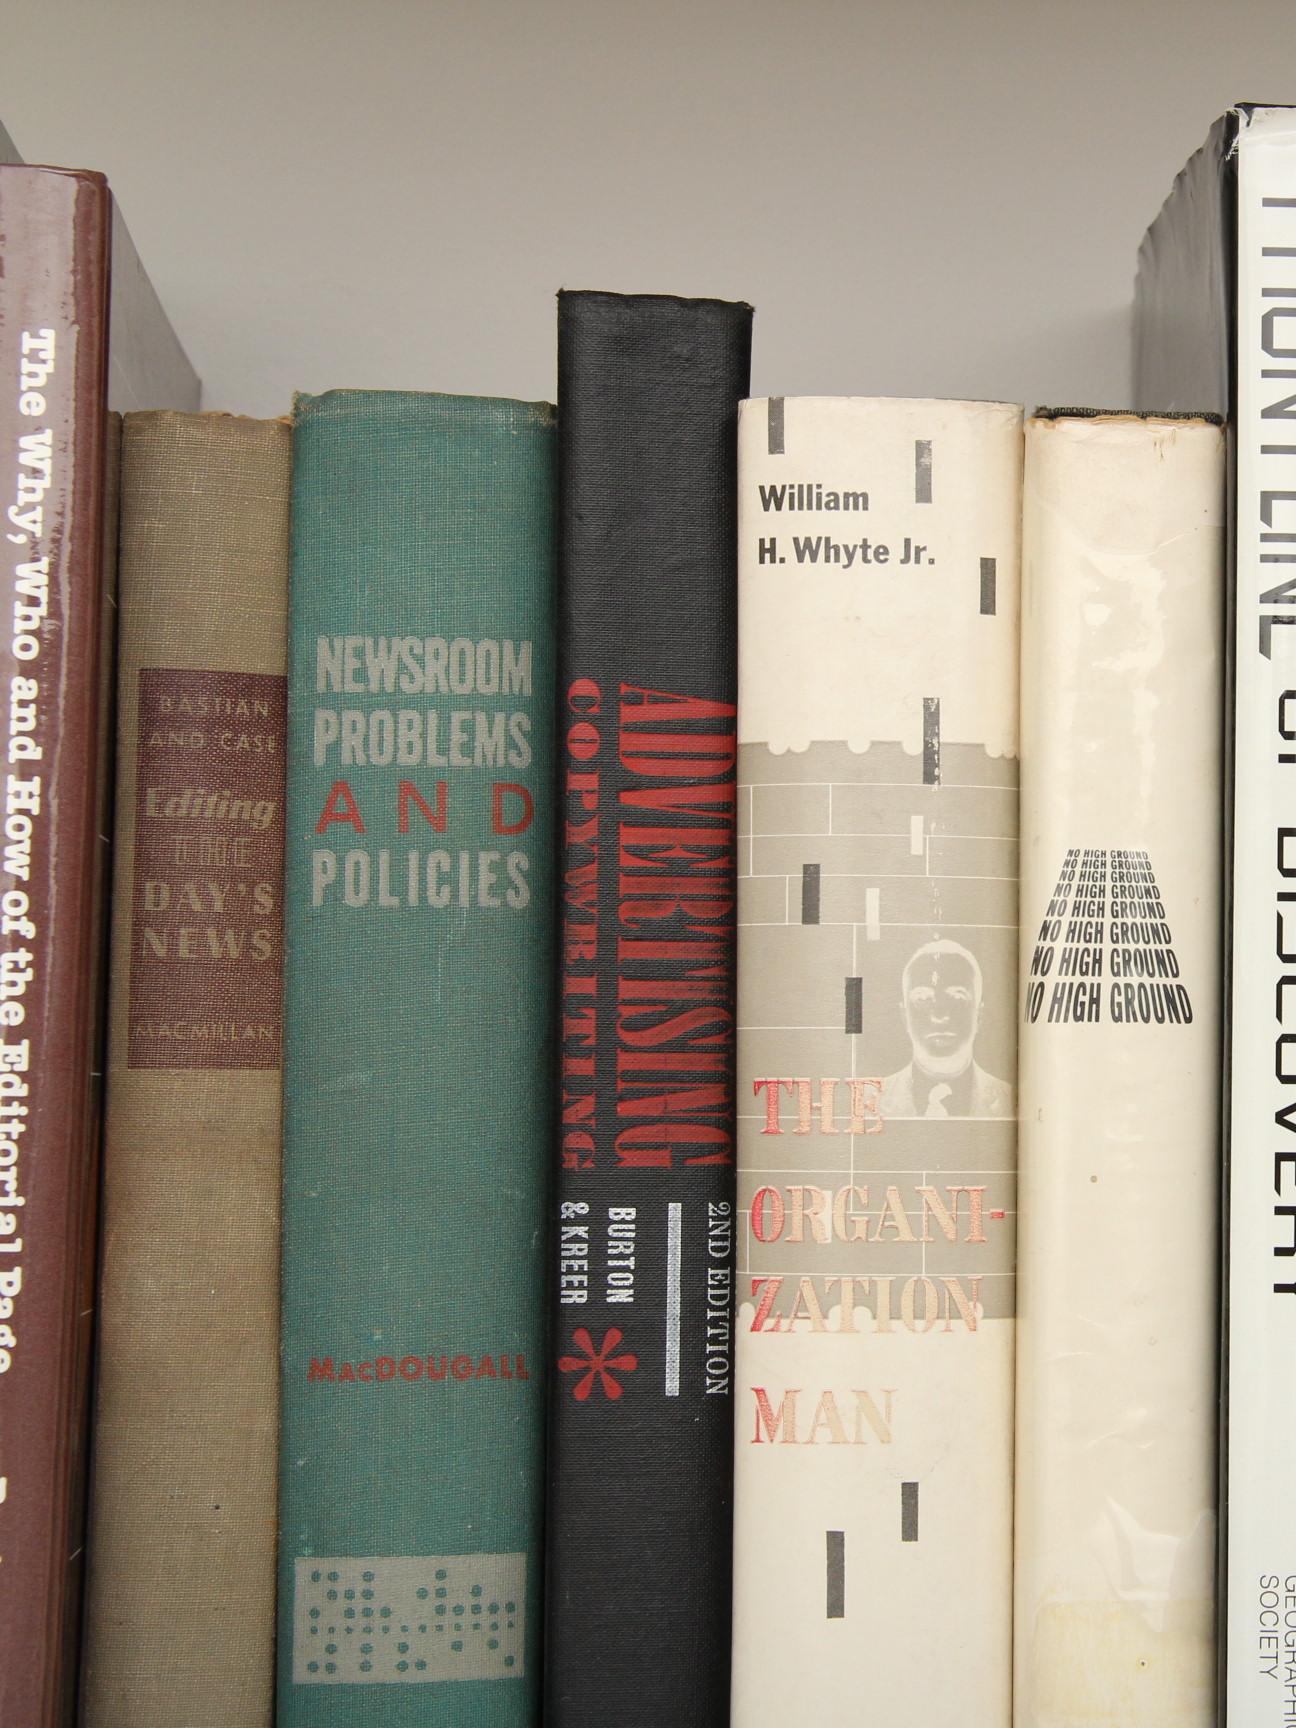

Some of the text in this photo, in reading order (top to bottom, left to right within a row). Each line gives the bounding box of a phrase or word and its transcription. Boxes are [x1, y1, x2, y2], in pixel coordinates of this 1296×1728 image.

[19, 328, 55, 416] The
[6, 428, 53, 544] Why,
[758, 484, 869, 512] William
[758, 536, 935, 569] H. Whyte Jr.
[12, 557, 49, 660] Who
[316, 636, 532, 697] NEWSROOM
[8, 676, 42, 763] and
[159, 695, 269, 717] BASTIAN
[149, 731, 278, 753] AND CASE
[313, 710, 532, 768] PROBLEMS
[5, 774, 41, 881] How
[145, 788, 276, 829] Editing
[315, 782, 535, 835] AND
[174, 836, 253, 868] THE
[312, 850, 531, 909] POLICIES
[1059, 870, 1155, 883] NO HIGH GROUND
[1063, 859, 1151, 870] NO HIGH GROUND
[1067, 849, 1148, 860] NO HIGH GROUND
[1, 890, 36, 940] of
[144, 880, 274, 915] DAY'S
[1046, 899, 1165, 919] NO HIGH GROUND
[1053, 883, 1160, 899] NO HIGH GROUND
[143, 927, 273, 960] NEWS
[562, 678, 600, 1171] COPYWRITING
[614, 681, 736, 1168] ADVERTISING
[1038, 920, 1172, 944] NO HIGH GROUND
[0, 948, 33, 1026] the
[1030, 946, 1179, 978] NO HIGH GROUND
[1047, 982, 1101, 1022] HIGH
[1110, 982, 1193, 1024] GROUND
[136, 1022, 273, 1042] MACMILLAN
[753, 1077, 884, 1135] THE
[0, 1038, 29, 1253] Editorial
[751, 1186, 1005, 1243] ORGANI-
[560, 1202, 590, 1304] & KREER
[606, 1207, 636, 1303] BURTON
[705, 1202, 731, 1396] 2ND EDITION
[749, 1276, 983, 1334] ZATION
[750, 1387, 898, 1444] MAN
[1259, 1575, 1279, 1680] SOCIETY
